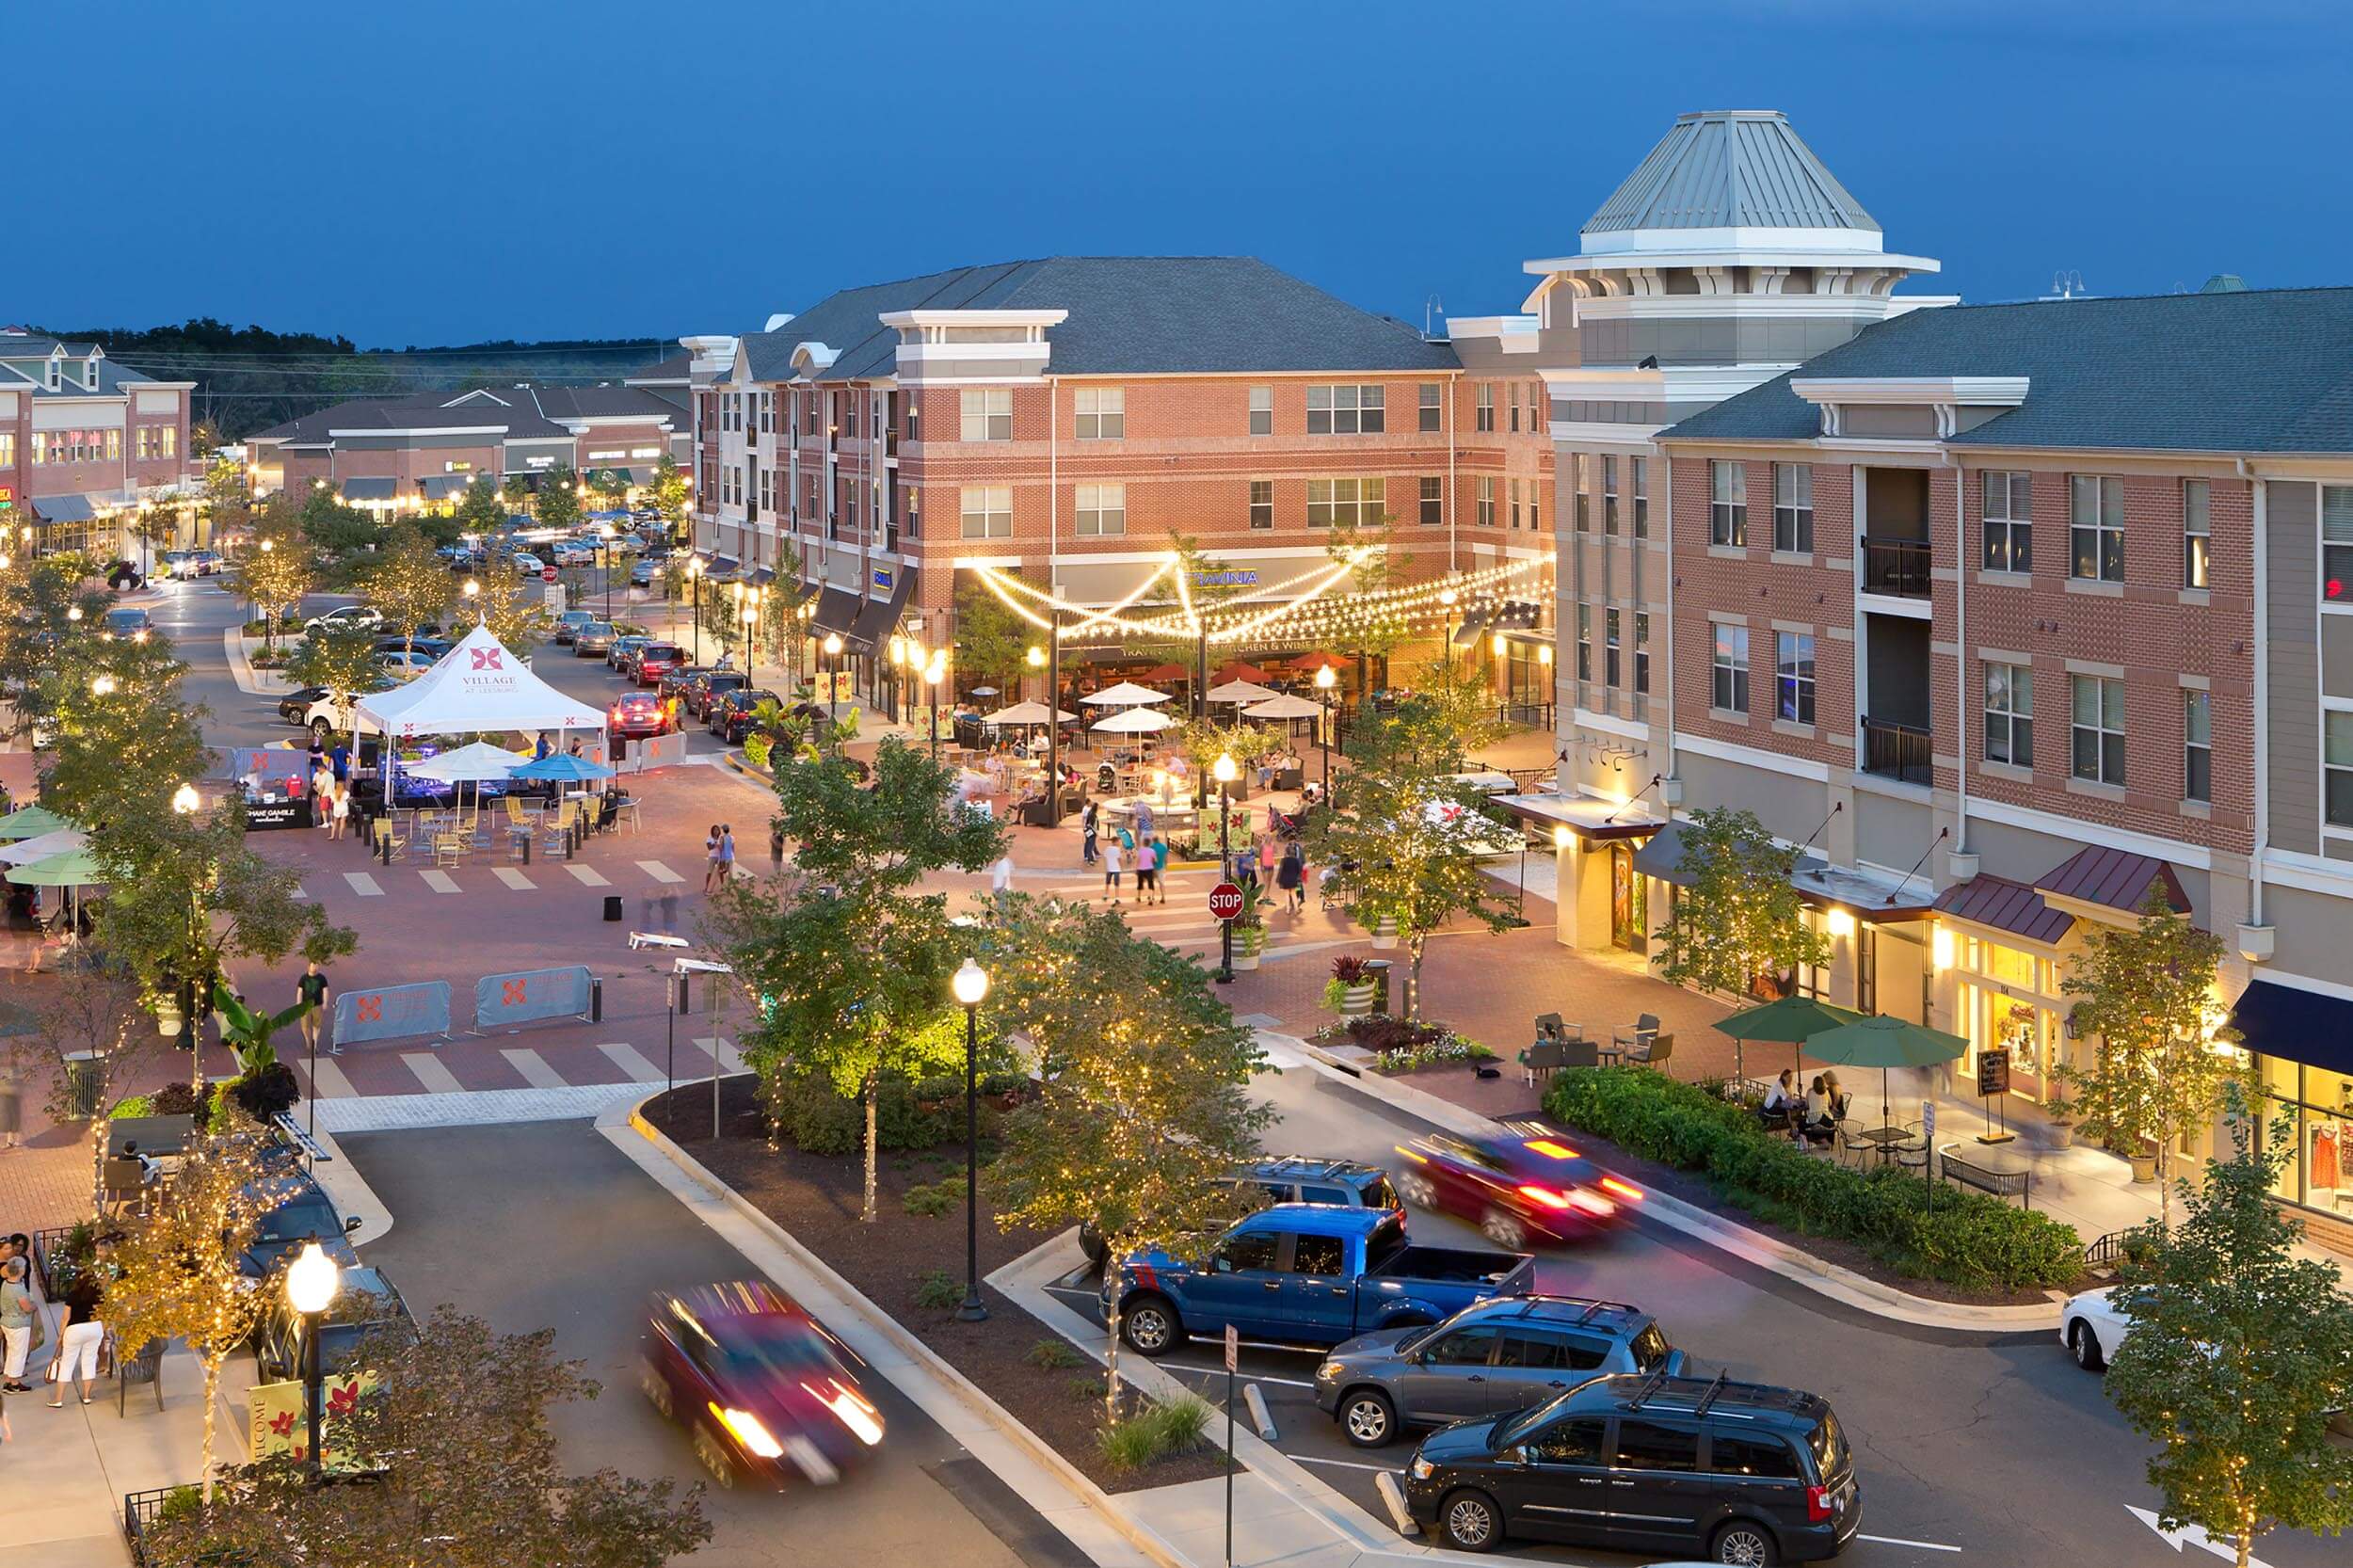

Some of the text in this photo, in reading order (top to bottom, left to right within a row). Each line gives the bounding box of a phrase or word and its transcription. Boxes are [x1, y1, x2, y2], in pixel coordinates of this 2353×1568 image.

[1272, 642, 1279, 650] &
[1282, 640, 1311, 649] WINE
[1316, 638, 1337, 648] BAR
[462, 677, 518, 685] VILLAGE
[1210, 894, 1241, 908] STOP
